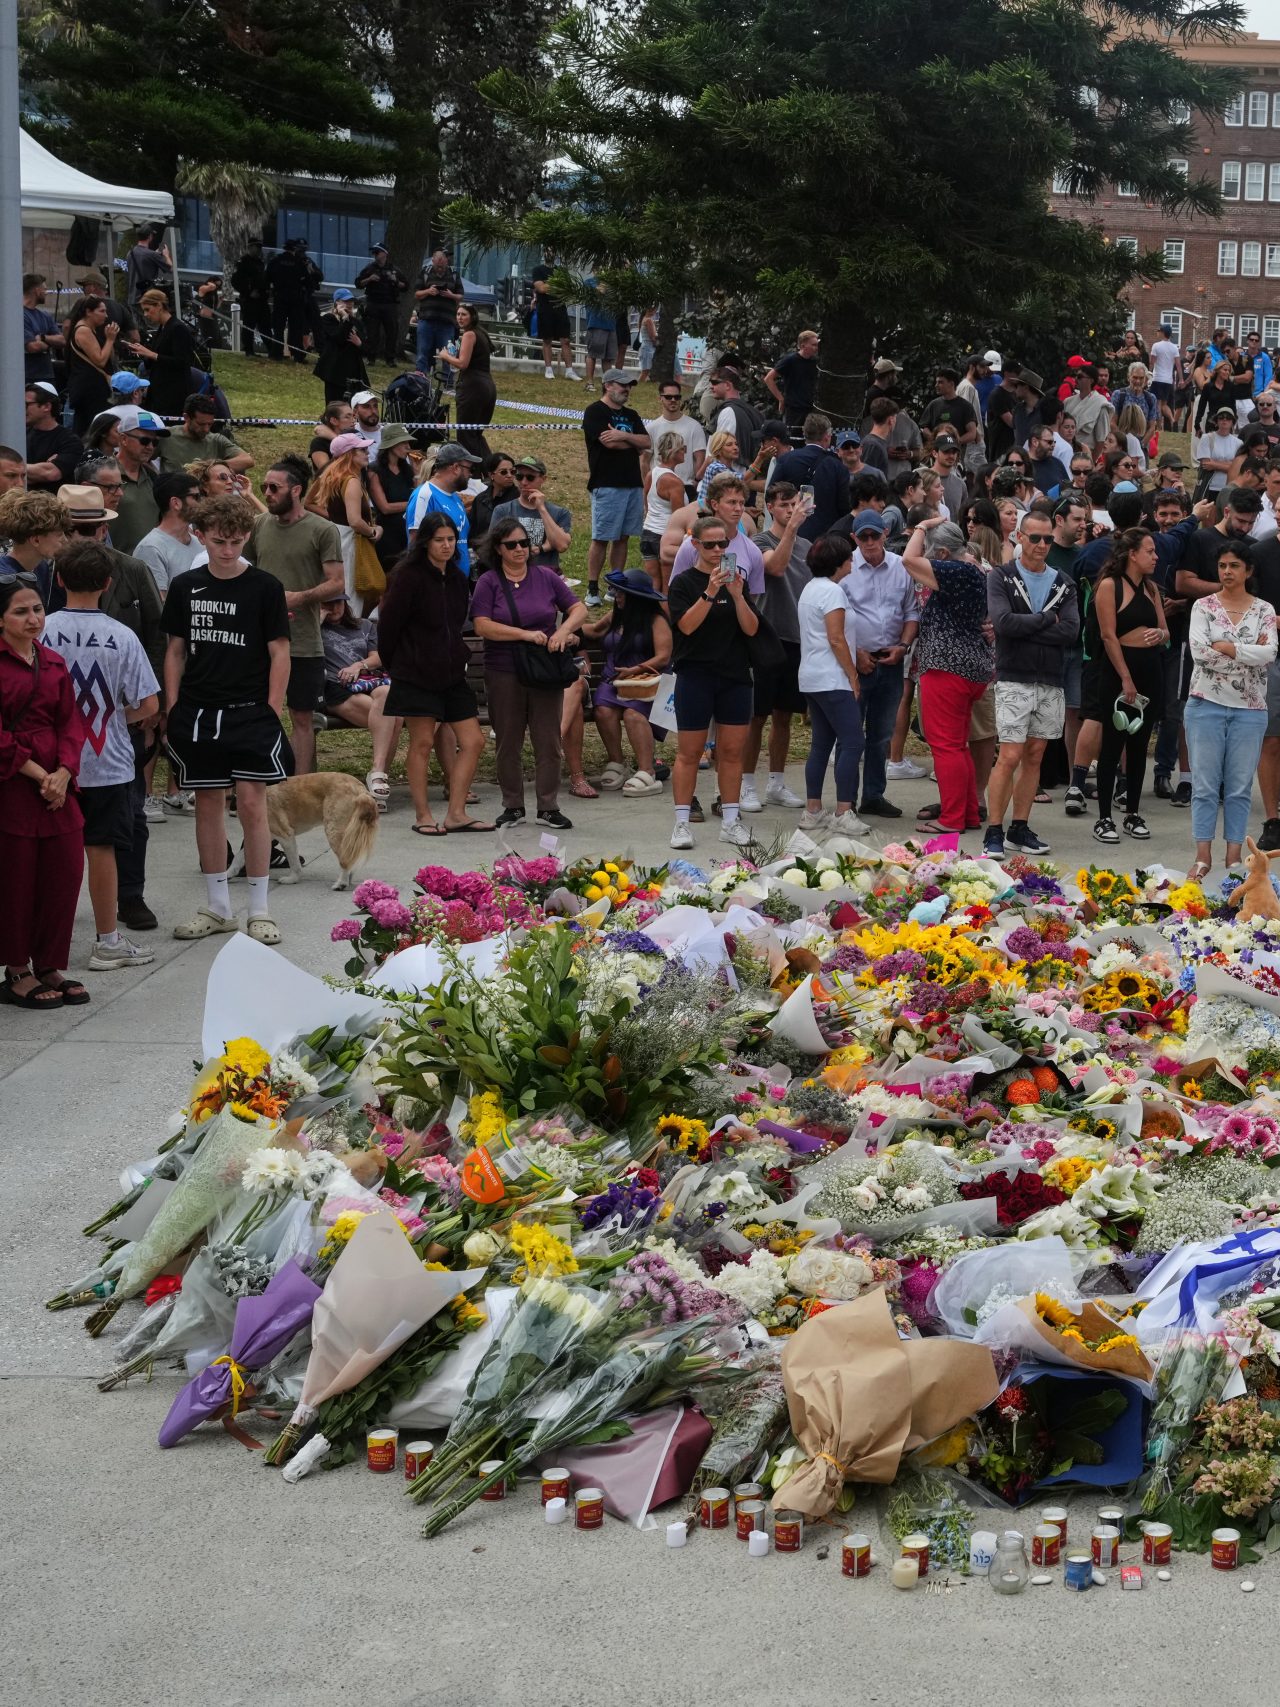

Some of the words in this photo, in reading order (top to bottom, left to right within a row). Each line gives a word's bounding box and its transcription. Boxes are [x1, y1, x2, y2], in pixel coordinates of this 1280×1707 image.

[190, 599, 237, 616] BROOKLYN
[191, 614, 214, 627] NETS
[190, 628, 246, 647] BASKETBALL
